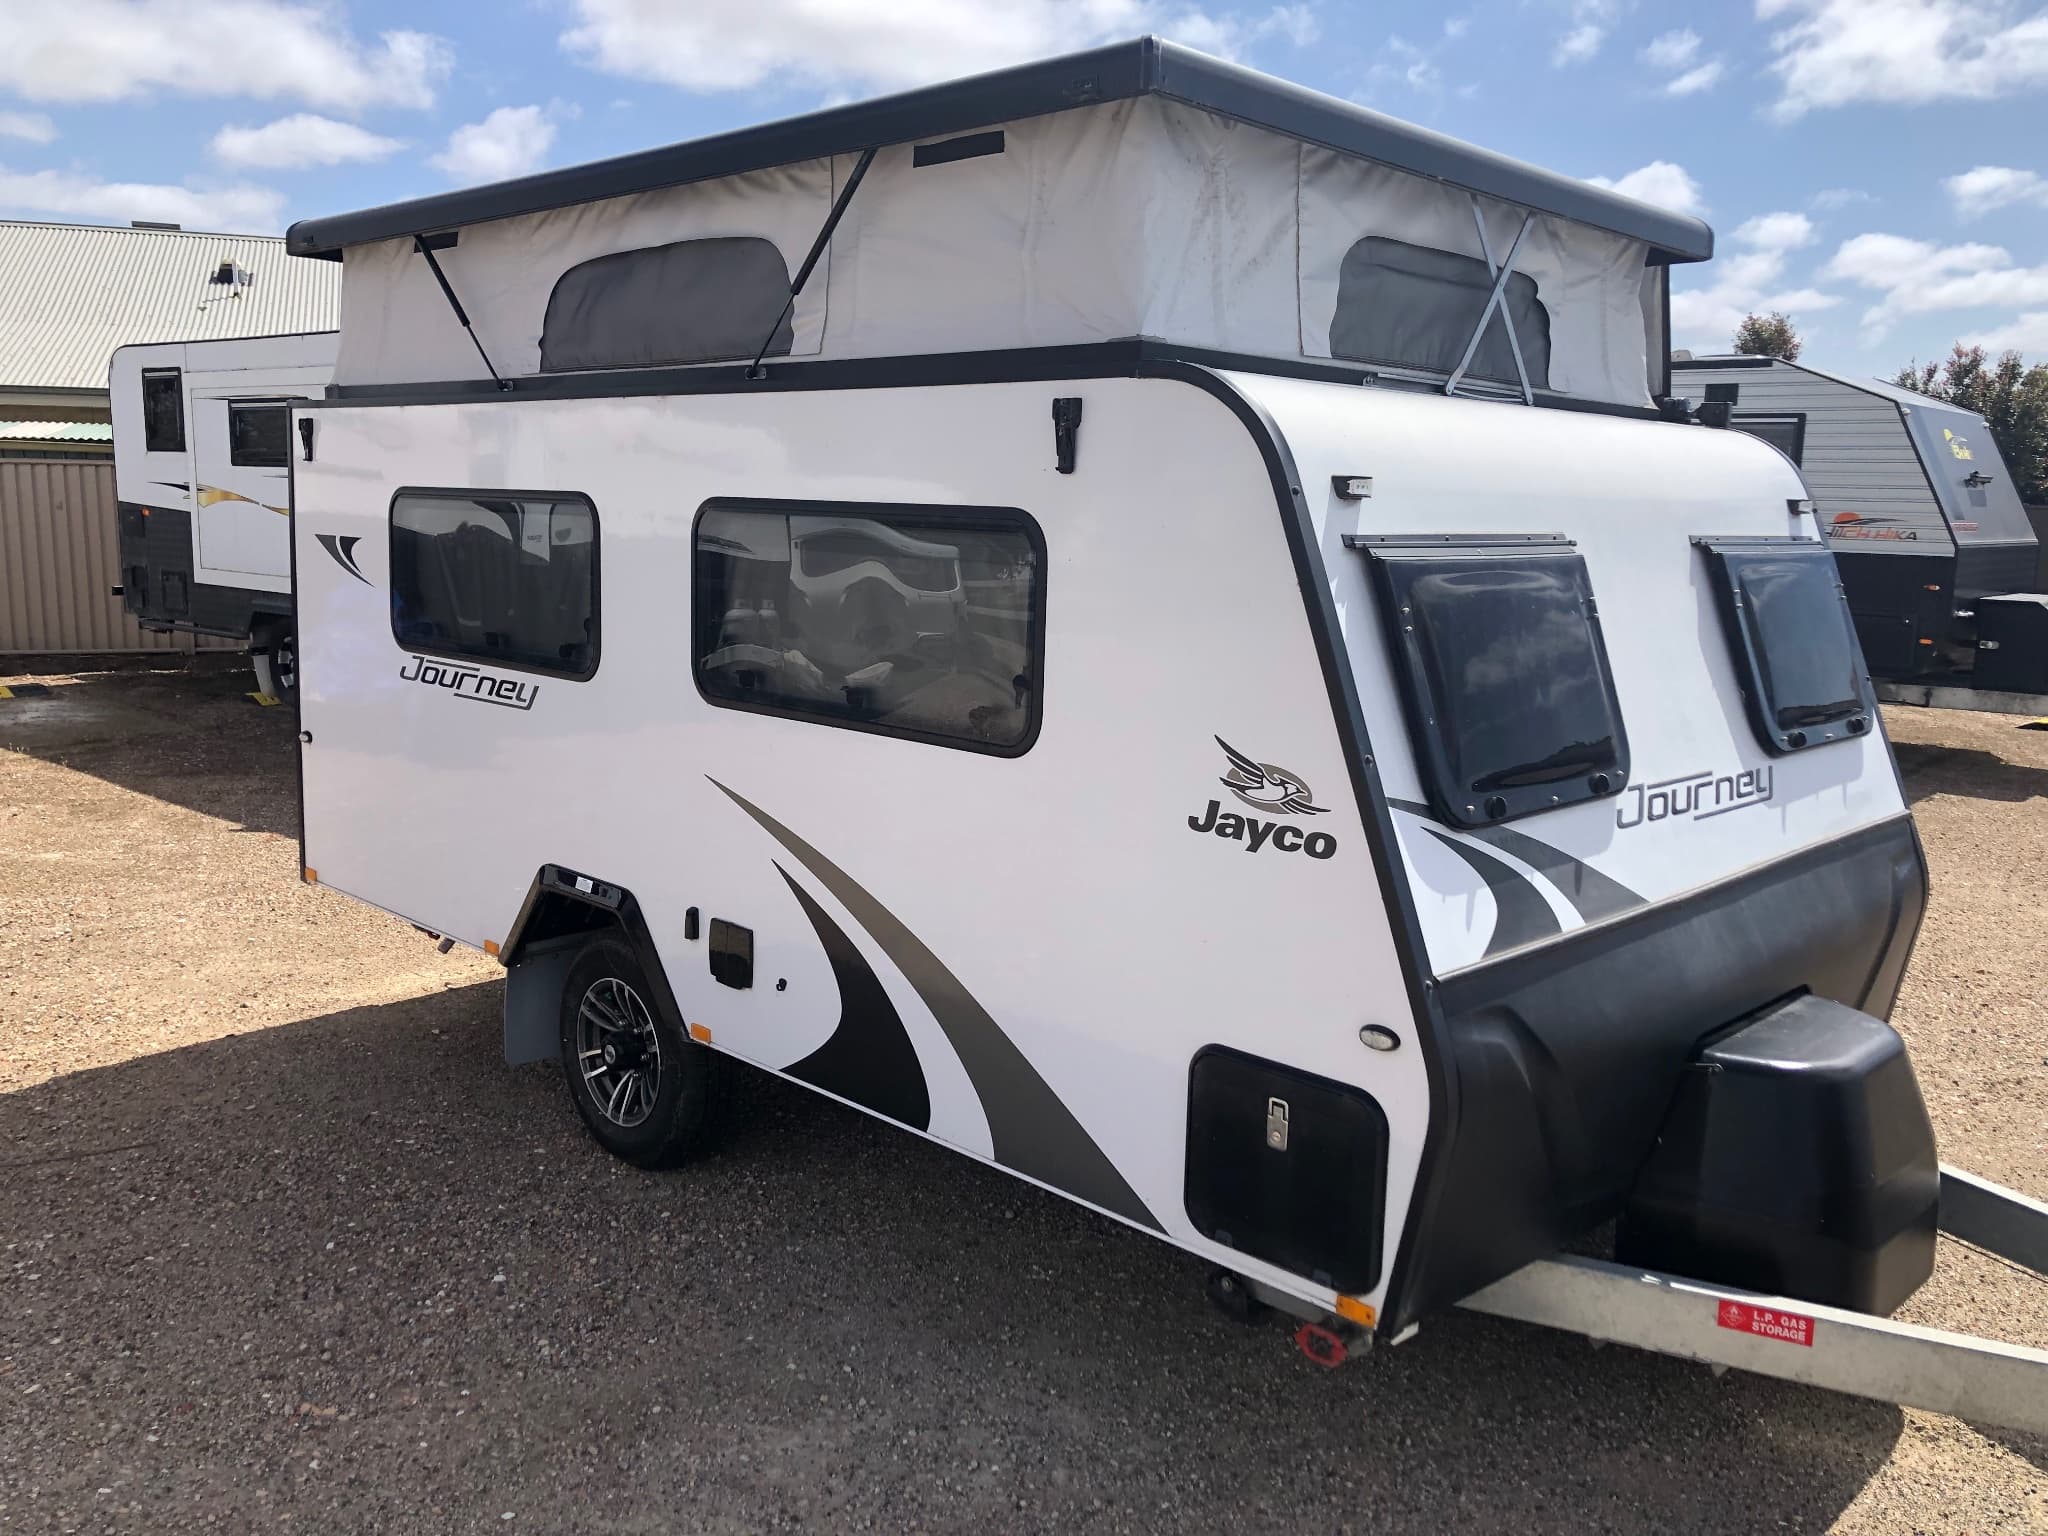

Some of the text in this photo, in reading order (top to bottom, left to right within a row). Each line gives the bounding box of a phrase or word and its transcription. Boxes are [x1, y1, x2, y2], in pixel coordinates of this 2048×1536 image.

[400, 655, 540, 711] Journey
[1616, 765, 1774, 830] Journey
[1187, 799, 1338, 860] Jayco
[1752, 1321, 1806, 1341] STORAGE
[1753, 1310, 1807, 1330] L.P. GAS
